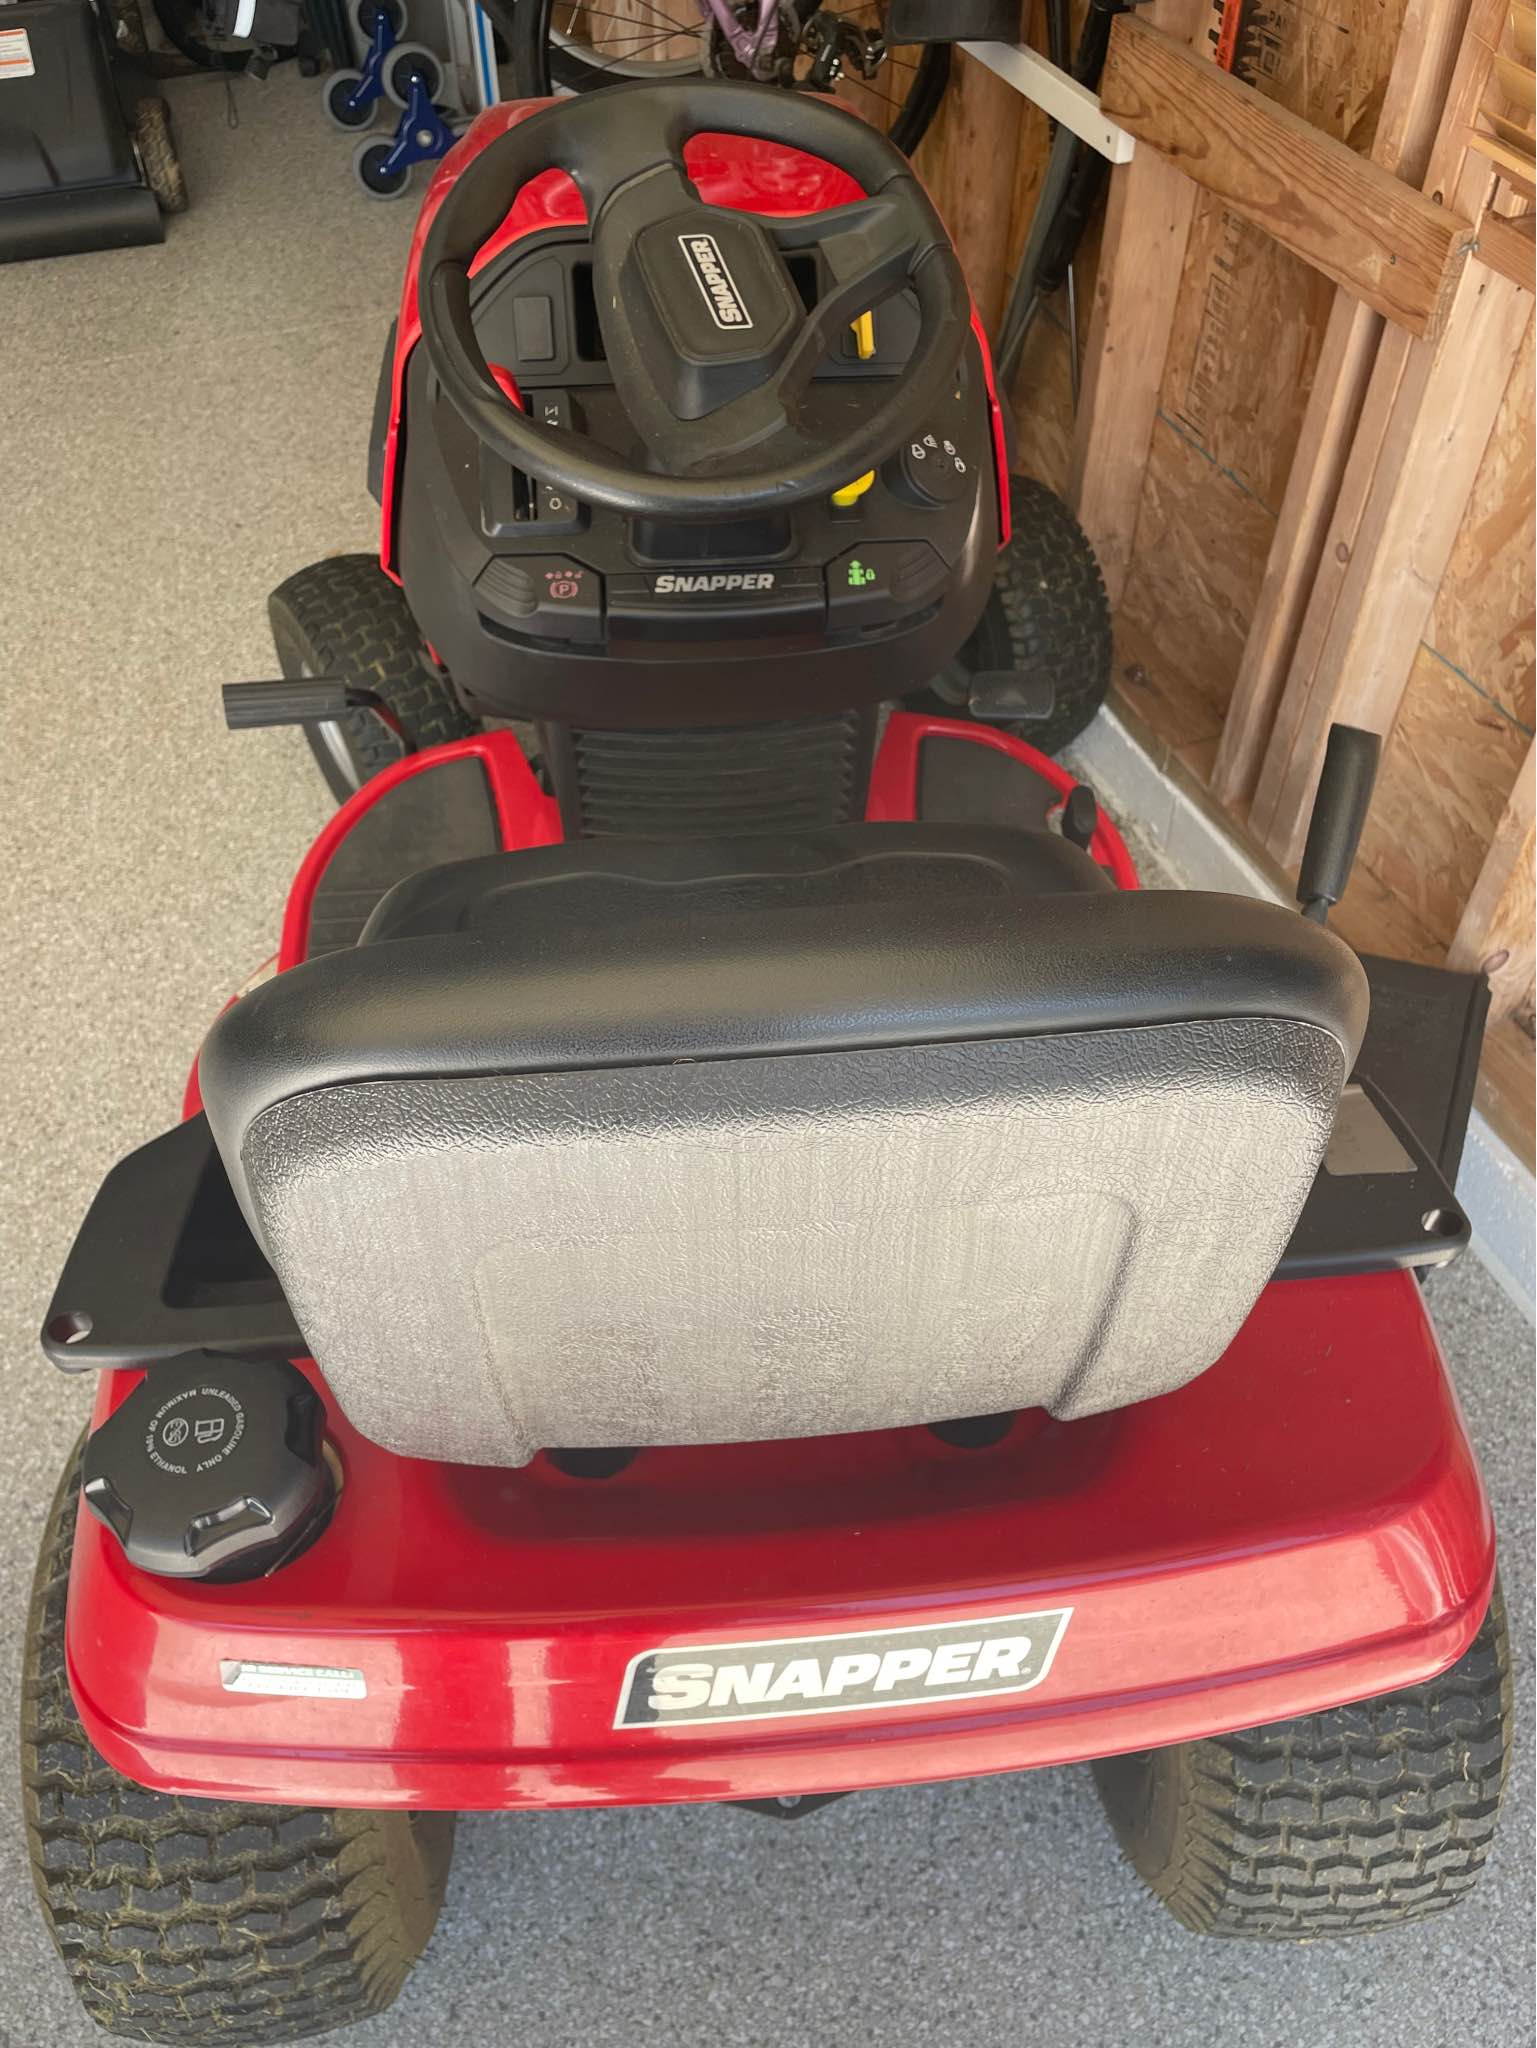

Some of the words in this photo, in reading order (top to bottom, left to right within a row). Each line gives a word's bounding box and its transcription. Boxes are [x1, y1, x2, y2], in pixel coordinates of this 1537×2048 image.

[690, 238, 743, 323] SNAPPER
[654, 573, 775, 593] SNAPPER
[155, 1388, 197, 1418] MAXIMUM
[201, 1387, 241, 1411] UNLEADED
[148, 1419, 159, 1432] OF
[221, 1412, 245, 1455] GASOLINE
[150, 1451, 188, 1474] ETHANOL
[196, 1454, 223, 1472] ONLY
[648, 1635, 1033, 1711] SNAPPER
